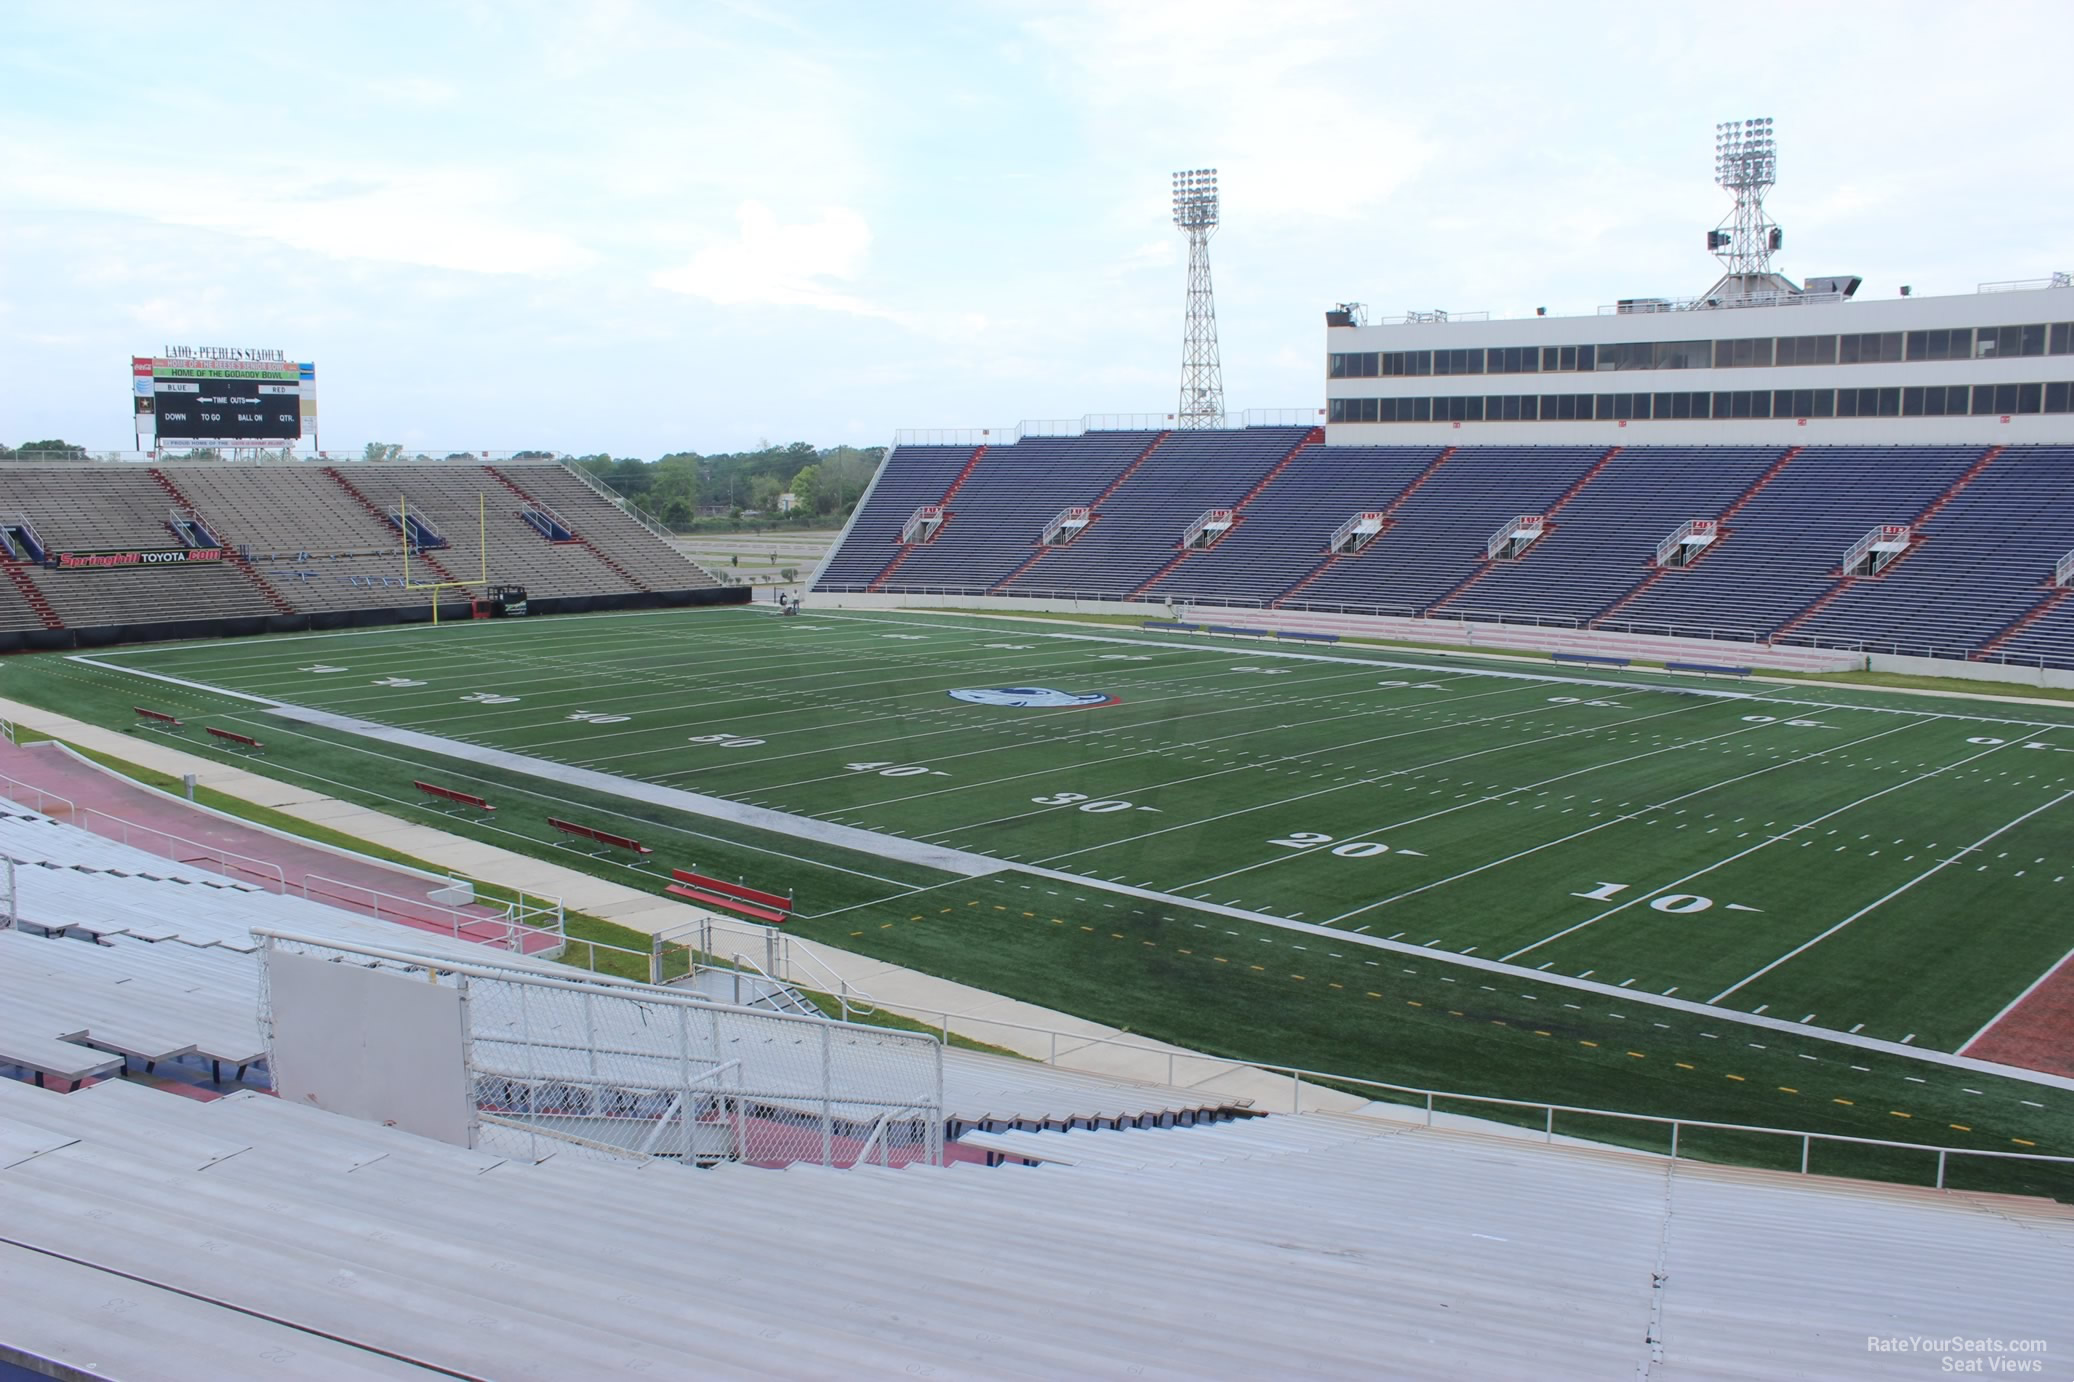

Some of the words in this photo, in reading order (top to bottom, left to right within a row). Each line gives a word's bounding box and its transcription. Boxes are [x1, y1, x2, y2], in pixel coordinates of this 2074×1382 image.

[165, 345, 192, 358] LADD
[199, 347, 243, 361] PEEBLES
[245, 349, 284, 361] STADIUM
[167, 360, 186, 368] HOME
[189, 360, 198, 368] OF
[200, 360, 212, 368] THE
[242, 361, 266, 370] SENIOR
[171, 369, 194, 377] HOME
[196, 369, 206, 377] OF
[213, 396, 228, 404] TIME
[230, 396, 246, 404] OUTS
[165, 413, 187, 421] DOWN
[201, 413, 210, 421] TO
[210, 413, 221, 421] GO
[237, 414, 253, 422] BALL
[254, 414, 263, 422] ON
[687, 732, 767, 749] 50
[843, 761, 930, 778] 40
[1030, 791, 1133, 814] 30
[1266, 831, 1391, 858] 20
[1569, 881, 1714, 914] 10
